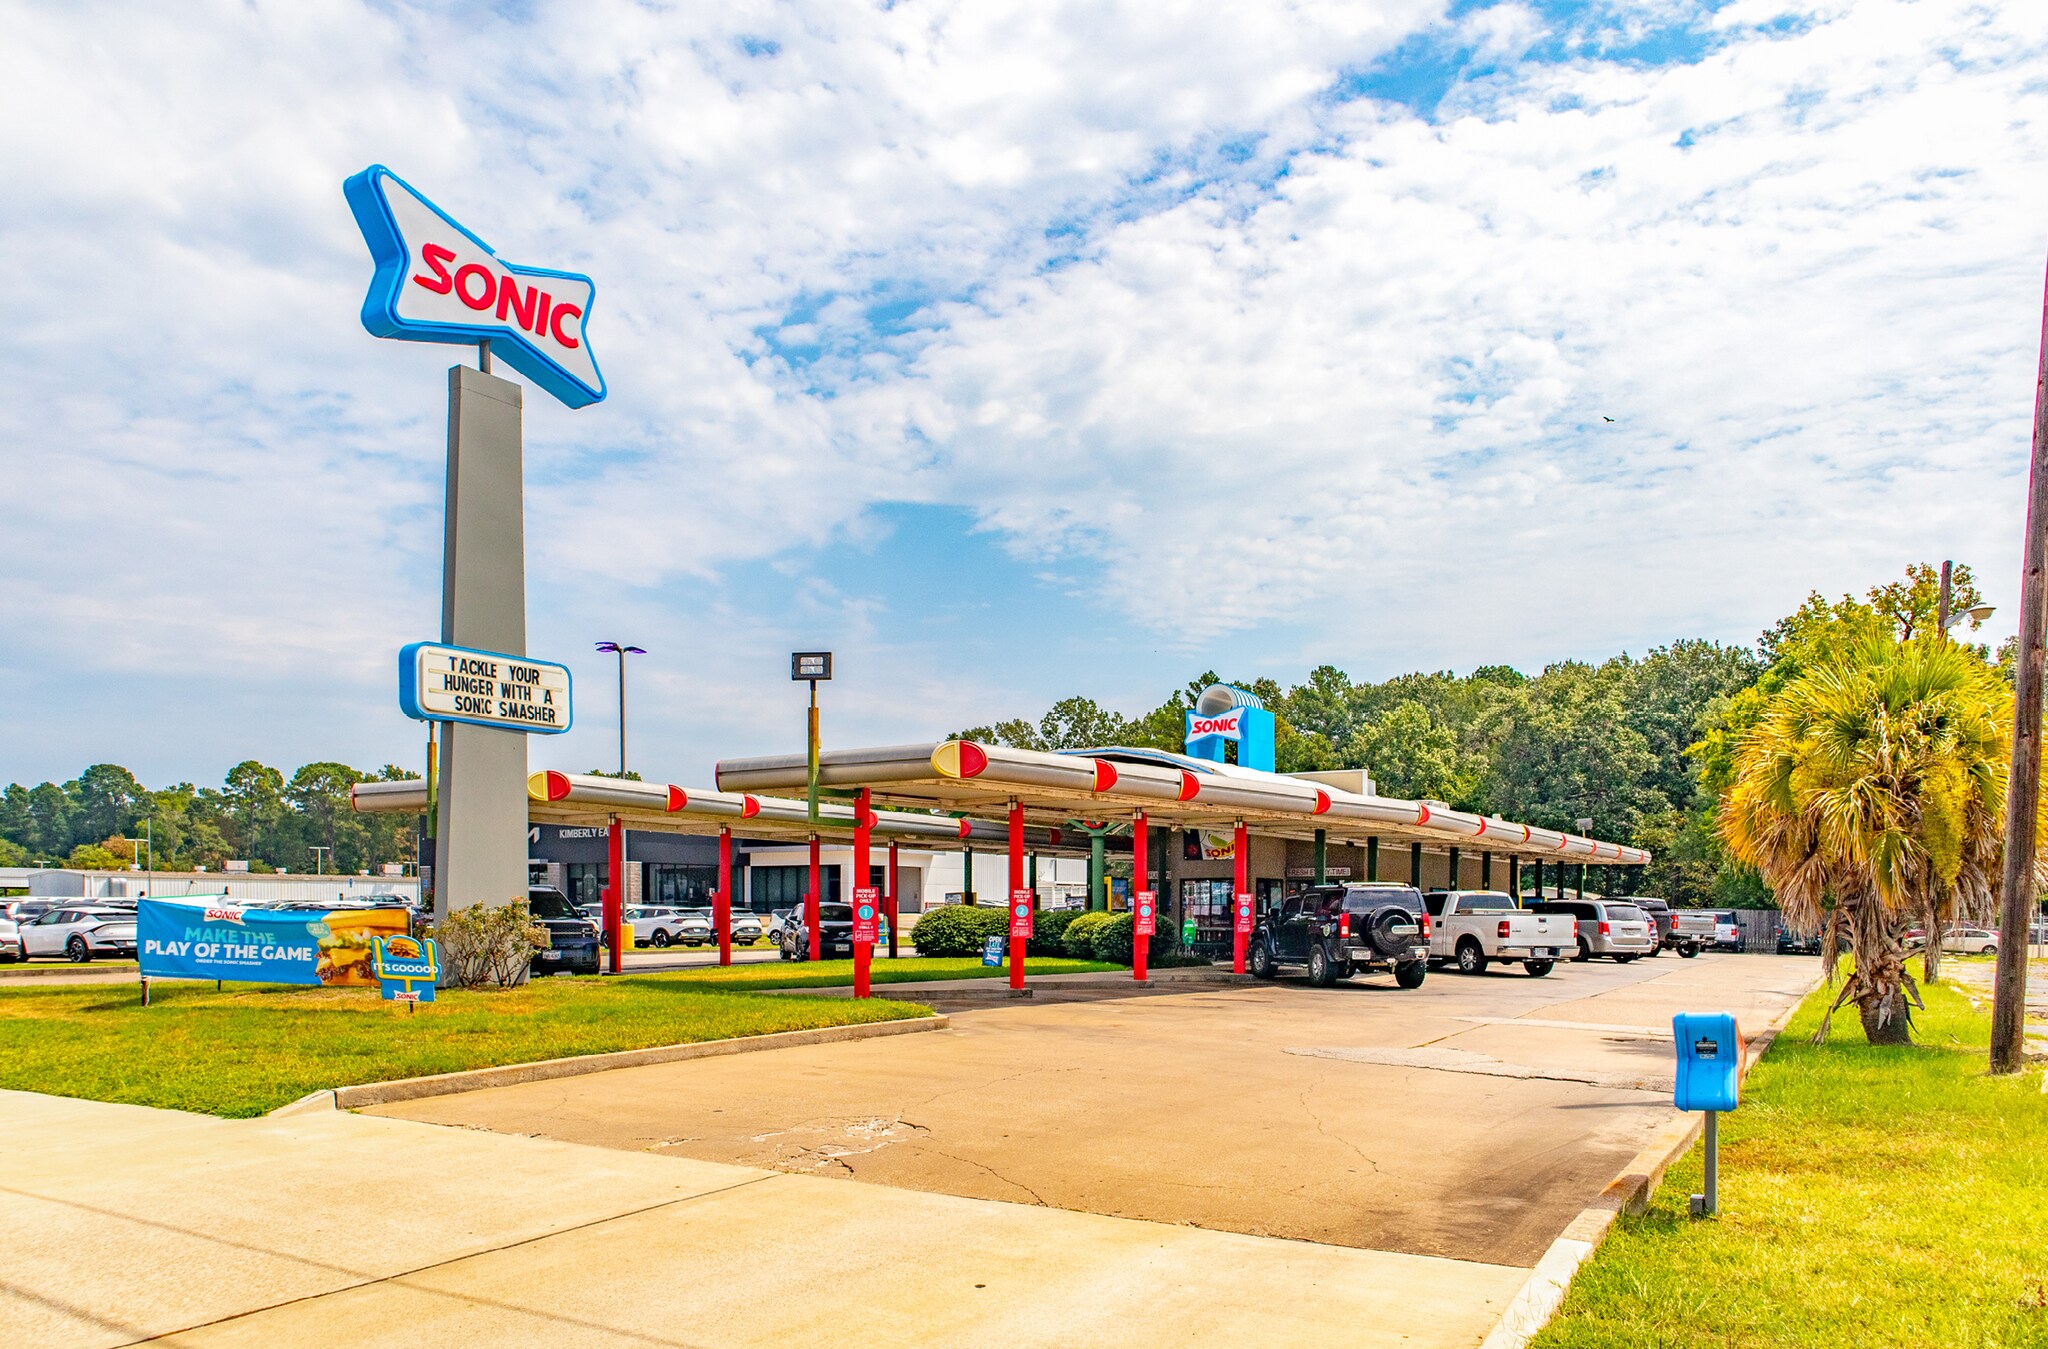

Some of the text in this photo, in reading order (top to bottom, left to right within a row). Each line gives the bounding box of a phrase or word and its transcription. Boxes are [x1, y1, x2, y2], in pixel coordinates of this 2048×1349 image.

[413, 242, 582, 348] SONIC
[449, 656, 540, 685] TACKLE YOUR
[444, 674, 553, 705] HUNGER WITH A
[455, 696, 556, 723] SONIC SMASHER
[1192, 718, 1237, 734] SONIC
[560, 828, 609, 838] KIMBERLY EA
[1205, 844, 1234, 857] SONI
[207, 909, 241, 920] SONIC
[184, 927, 276, 945] MAKE THE
[145, 940, 312, 961] PLAY OF THE GAME
[373, 963, 438, 973] IT'S GOOOOD
[396, 992, 418, 1000] SONIC
